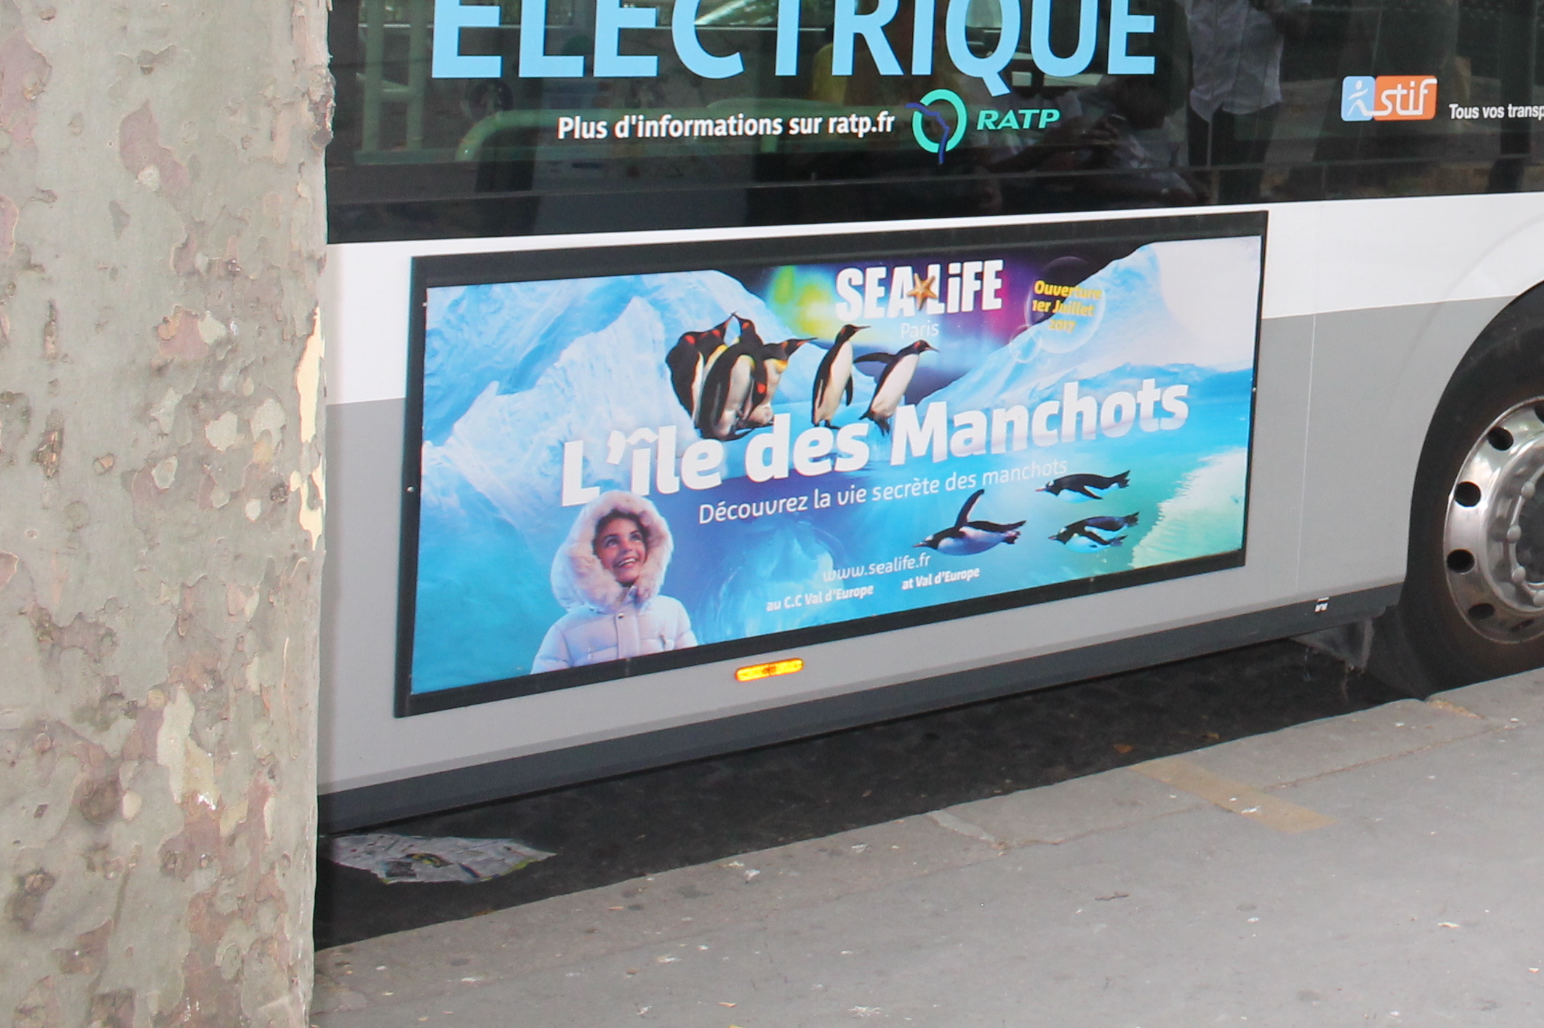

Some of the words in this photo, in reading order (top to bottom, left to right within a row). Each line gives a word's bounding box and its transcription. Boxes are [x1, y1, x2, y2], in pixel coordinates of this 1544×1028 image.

[1378, 77, 1439, 117] stif
[976, 108, 1061, 130] RATP
[1449, 103, 1479, 120] Tous
[1482, 105, 1505, 120] vos
[557, 115, 608, 140] Plus
[614, 110, 783, 138] d'informations
[788, 116, 822, 136] sur
[828, 110, 896, 140] ratp.fr
[835, 265, 916, 322] SEA
[1033, 279, 1102, 300] Ouverture
[1032, 299, 1051, 313] 1er
[1051, 299, 1096, 316] Juillet
[900, 319, 940, 339] Paris
[1048, 318, 1077, 334] 2017
[561, 424, 724, 508] L'île
[745, 412, 870, 484] des
[889, 378, 1190, 466] Manchots
[699, 493, 809, 525] Découvrez
[813, 489, 832, 510] la
[836, 483, 867, 506] vie
[872, 476, 940, 502] secrète
[945, 471, 977, 492] des
[982, 458, 1069, 487] manchots
[822, 552, 932, 583] www.sealife.fr
[902, 578, 914, 591] at
[915, 573, 932, 588] Val
[934, 567, 981, 586] d'Europe
[766, 600, 782, 613] au
[805, 592, 823, 606] Val
[825, 584, 875, 604] d'Europe
